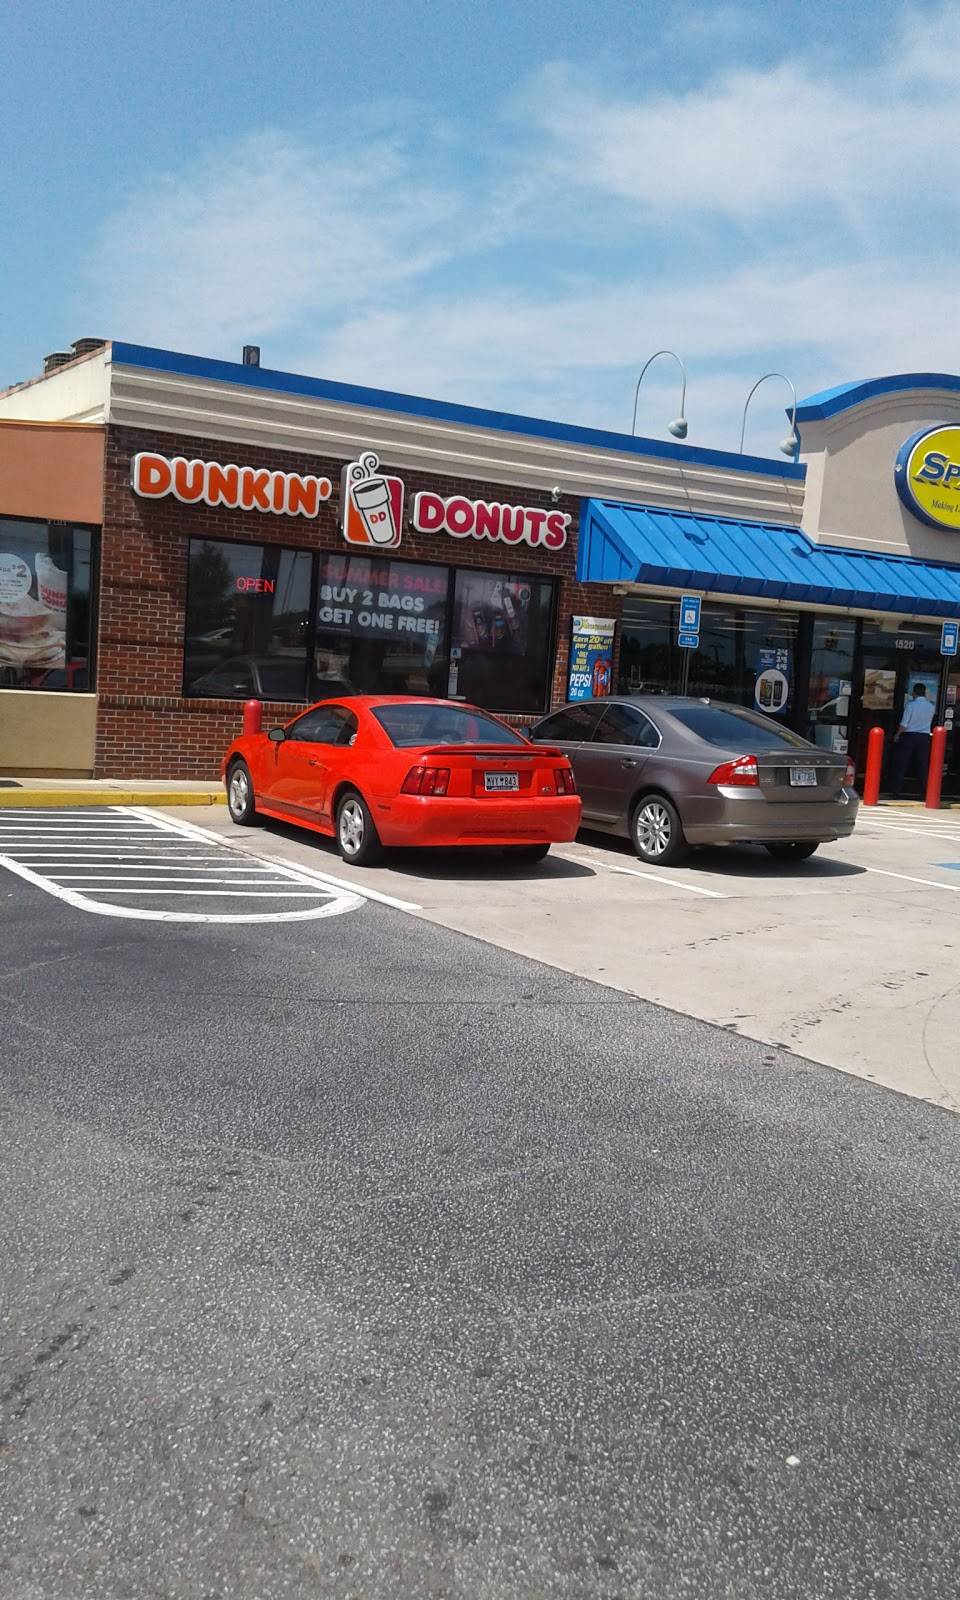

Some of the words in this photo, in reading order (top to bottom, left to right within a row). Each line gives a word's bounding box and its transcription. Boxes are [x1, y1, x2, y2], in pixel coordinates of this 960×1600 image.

[136, 454, 332, 517] DUNKIN'
[369, 511, 387, 524] DD
[417, 492, 567, 549] DONUTS
[236, 576, 275, 593] OPEN
[320, 585, 358, 603] BUY
[361, 590, 374, 606] 2
[378, 592, 425, 612] BAGS
[319, 606, 354, 625] GET
[357, 611, 394, 630] ONE
[397, 615, 440, 634] FREE!
[573, 635, 589, 643] Earn
[895, 639, 915, 650] 1520
[569, 673, 592, 687] PEPSI
[570, 688, 578, 697] 20
[486, 776, 499, 785] MVY
[504, 776, 517, 785] 843
